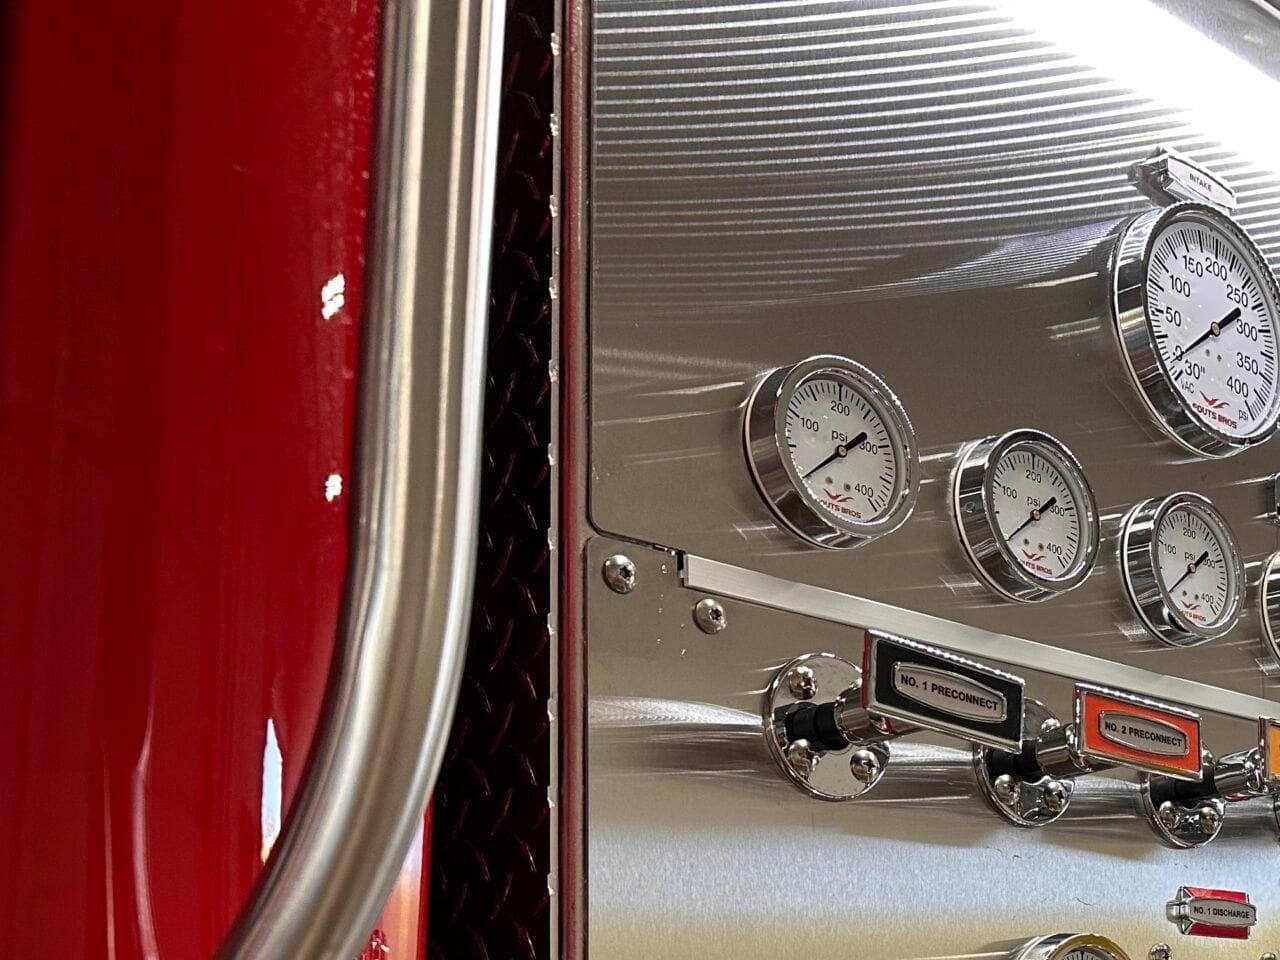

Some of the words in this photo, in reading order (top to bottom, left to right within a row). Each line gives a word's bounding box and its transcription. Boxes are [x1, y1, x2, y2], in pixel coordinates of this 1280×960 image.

[1190, 173, 1212, 192] INTAKE
[1183, 255, 1203, 277] 150
[1206, 257, 1227, 280] 200
[1170, 275, 1190, 297] 100
[1226, 284, 1248, 307] 250
[1165, 307, 1181, 326] 50
[1236, 319, 1257, 341] 300
[1236, 351, 1258, 375] 350
[1227, 376, 1248, 397] 400
[830, 400, 850, 416] 200
[800, 417, 819, 432] 100
[1217, 414, 1237, 429] BROS
[831, 430, 848, 443] psi
[859, 441, 878, 455] 300
[1025, 470, 1041, 483] 200
[854, 483, 874, 498] 400
[1002, 485, 1017, 499] 100
[1027, 496, 1041, 507] psi
[841, 506, 862, 519] BROS
[1050, 504, 1065, 517] 300
[1183, 527, 1196, 539] 200
[1046, 543, 1062, 556] 400
[1164, 543, 1177, 555] 100
[1184, 551, 1196, 561] psi
[1203, 558, 1216, 569] 300
[1201, 593, 1214, 604] 400
[900, 673, 919, 688] NO.
[922, 681, 928, 691] 1
[931, 683, 998, 711] PRECONNECT
[1104, 721, 1119, 732] NO.
[1121, 726, 1127, 734] 2
[1129, 727, 1182, 747] PRECONNECT
[1193, 906, 1206, 915] NO.
[1212, 908, 1250, 919] DISCHARGE
